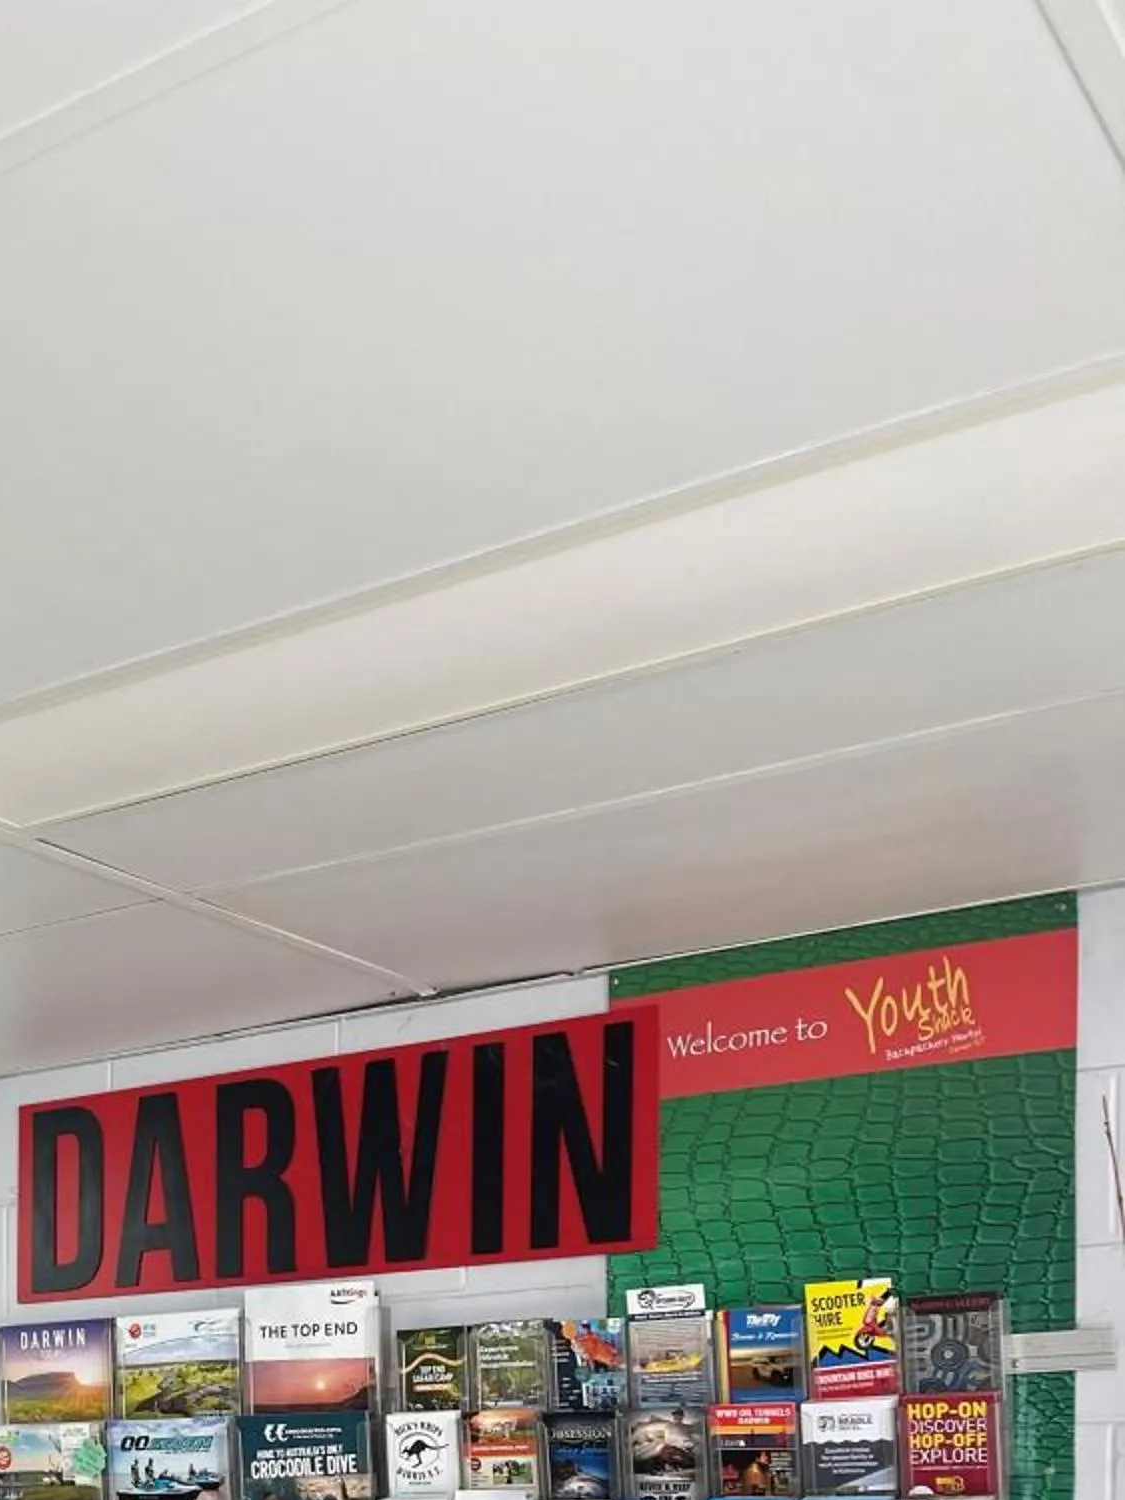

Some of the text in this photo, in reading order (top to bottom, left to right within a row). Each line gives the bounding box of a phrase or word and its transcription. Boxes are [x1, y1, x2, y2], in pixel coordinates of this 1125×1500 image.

[845, 955, 970, 1054] Youth
[918, 1003, 976, 1041] Shack
[667, 1017, 828, 1058] Welcome to
[31, 1021, 634, 1294] DARWIN
[811, 1292, 866, 1313] SCOOTER
[812, 1311, 844, 1327] HIRE
[19, 1327, 87, 1351] DARWIN
[259, 1321, 359, 1339] THE TOP END
[907, 1401, 987, 1419] HOP-ON
[908, 1418, 987, 1434] DISCOVER
[909, 1432, 987, 1448] HOP-OFF
[250, 1453, 358, 1480] CROCODILE DIVE
[910, 1448, 988, 1464] EXPLORE
